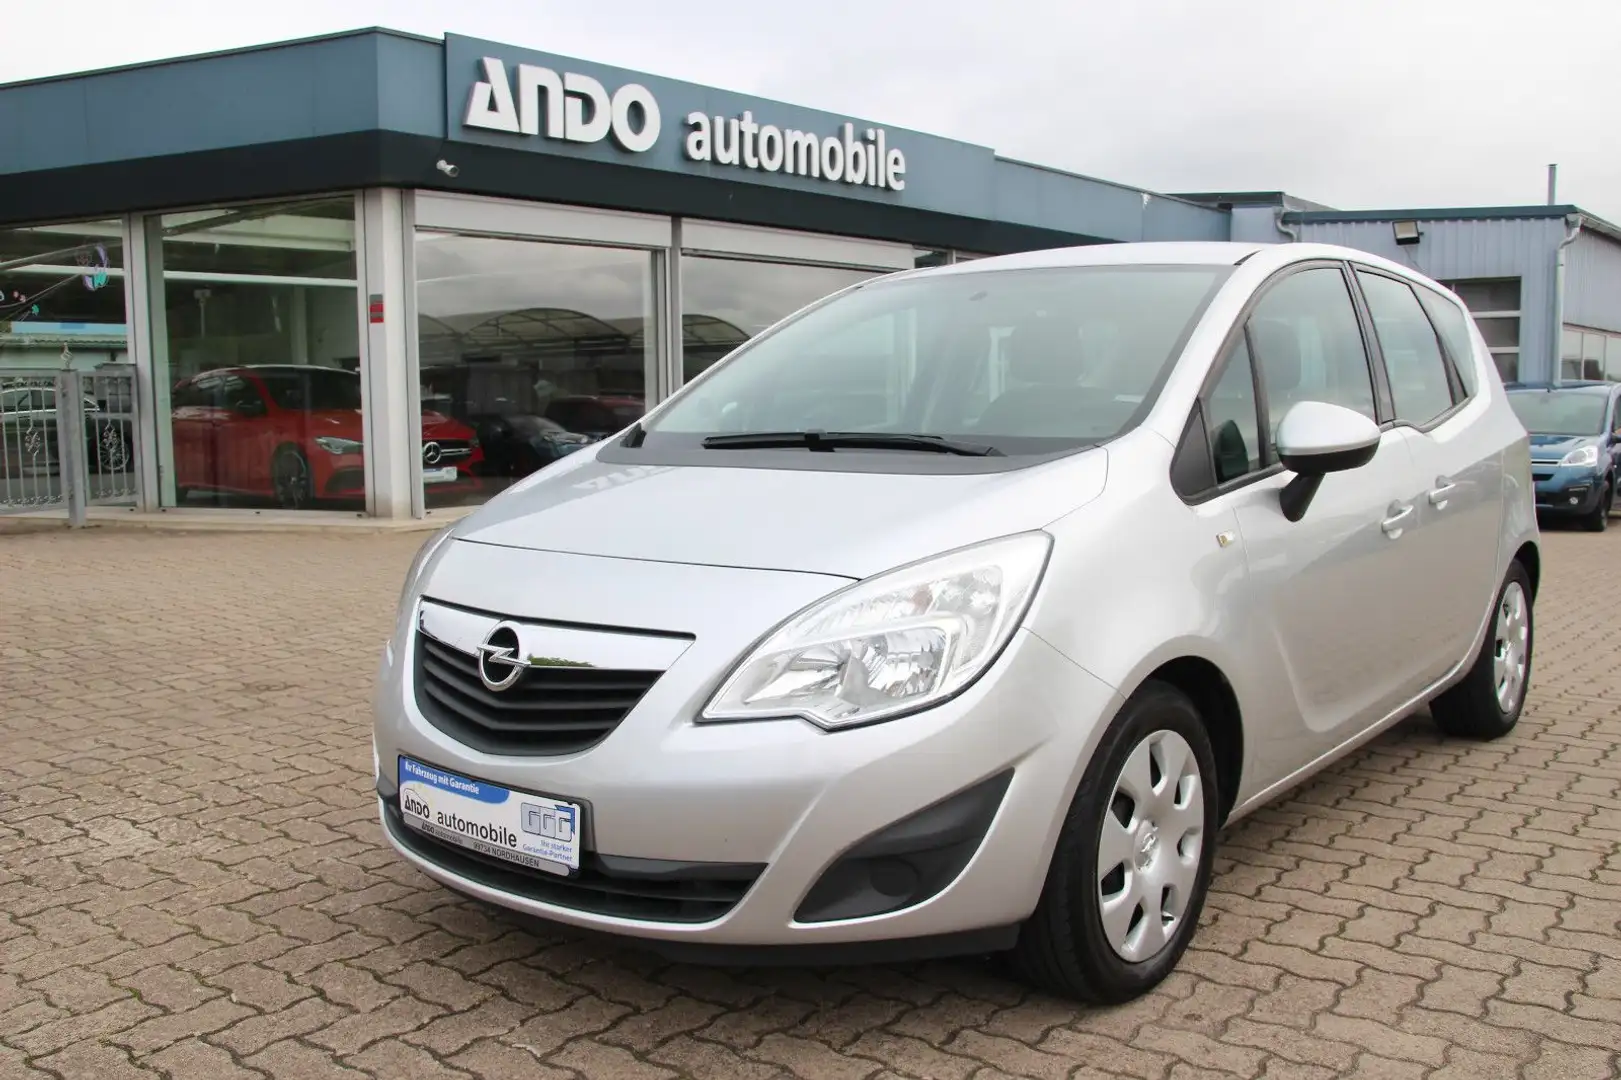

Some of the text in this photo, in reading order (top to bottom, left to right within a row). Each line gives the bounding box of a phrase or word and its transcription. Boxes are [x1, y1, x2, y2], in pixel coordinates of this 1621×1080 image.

[462, 56, 907, 191] ANDO automobile
[405, 761, 479, 794] Ihr Fahrzeug mit Garantie
[404, 794, 517, 848] ANDO automobile
[473, 842, 491, 854] 99734
[492, 847, 540, 867] NORDHAUSEN
[522, 843, 573, 861] Garantie-Partner
[551, 842, 573, 852] starker
